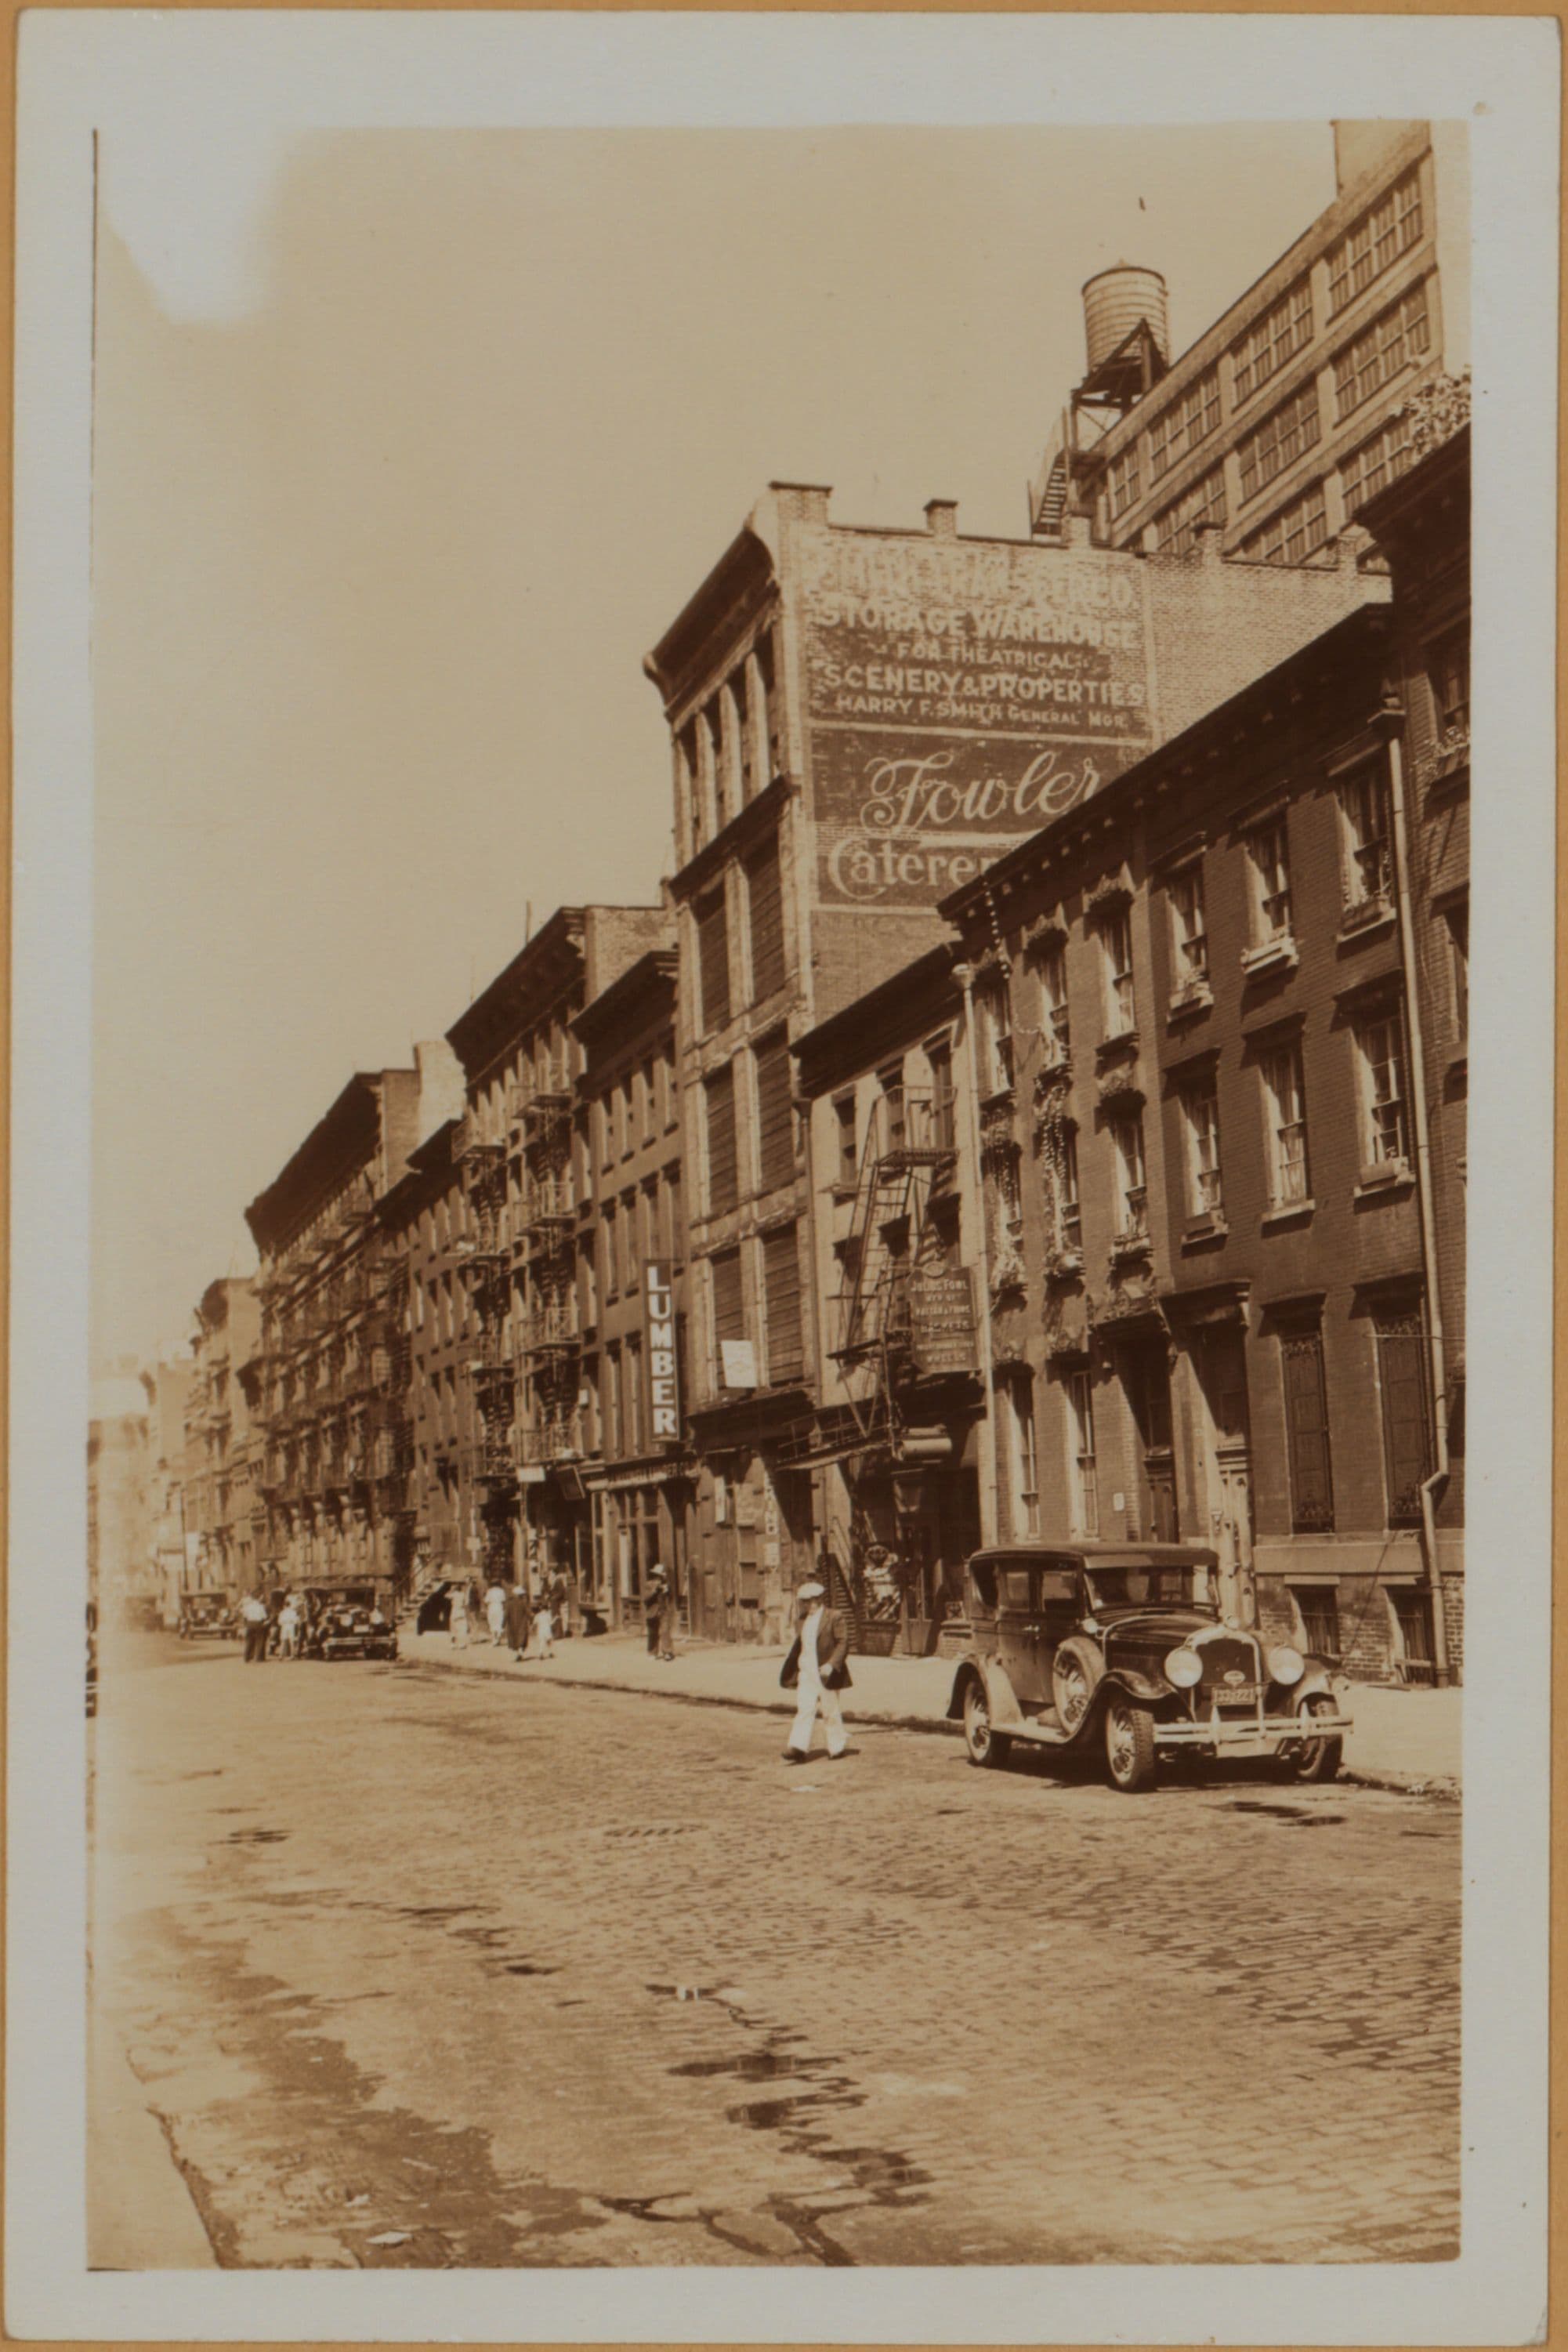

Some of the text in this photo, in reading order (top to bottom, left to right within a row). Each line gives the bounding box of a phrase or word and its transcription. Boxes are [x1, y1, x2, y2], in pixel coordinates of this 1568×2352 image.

[817, 593, 1139, 649] STORAGE WAREHOUSE
[897, 639, 1081, 671] FOR THEATRICAL
[824, 662, 963, 697] SCENERY
[980, 672, 1144, 705] PROPERTIES
[835, 694, 914, 715] HARRY
[936, 700, 1002, 721] SMITH
[860, 750, 1100, 839] Fowler
[646, 1265, 677, 1435] LUMBER
